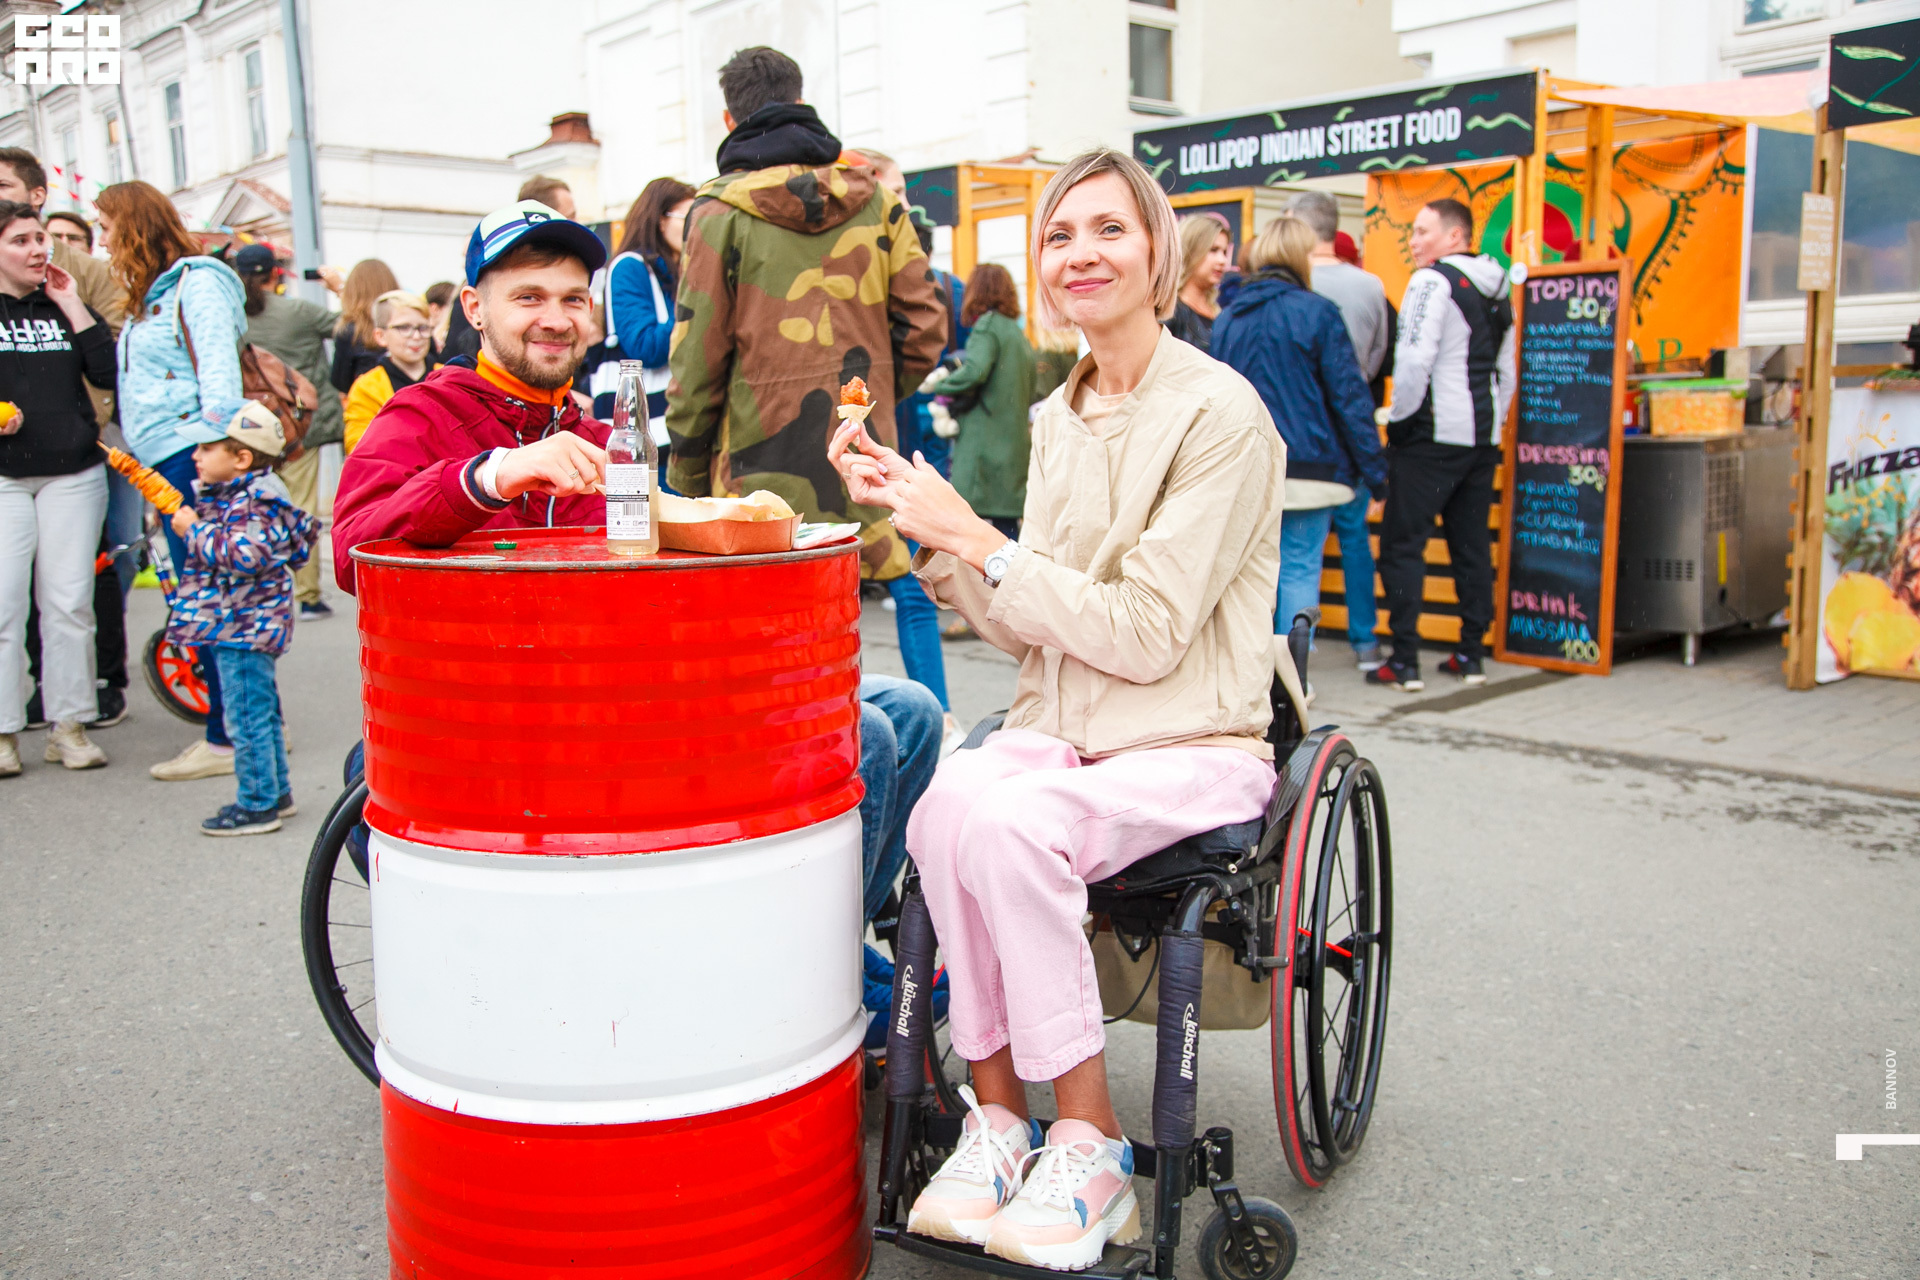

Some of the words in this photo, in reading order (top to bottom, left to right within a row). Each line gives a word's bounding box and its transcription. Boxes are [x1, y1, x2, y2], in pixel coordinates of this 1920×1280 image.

[1179, 136, 1260, 176] LOLLIPOP
[1261, 126, 1325, 165] INDIAN
[1327, 114, 1403, 157] STREET
[1405, 106, 1462, 147] FOOD
[896, 979, 919, 1038] küschall
[1180, 1018, 1198, 1080] küschall
